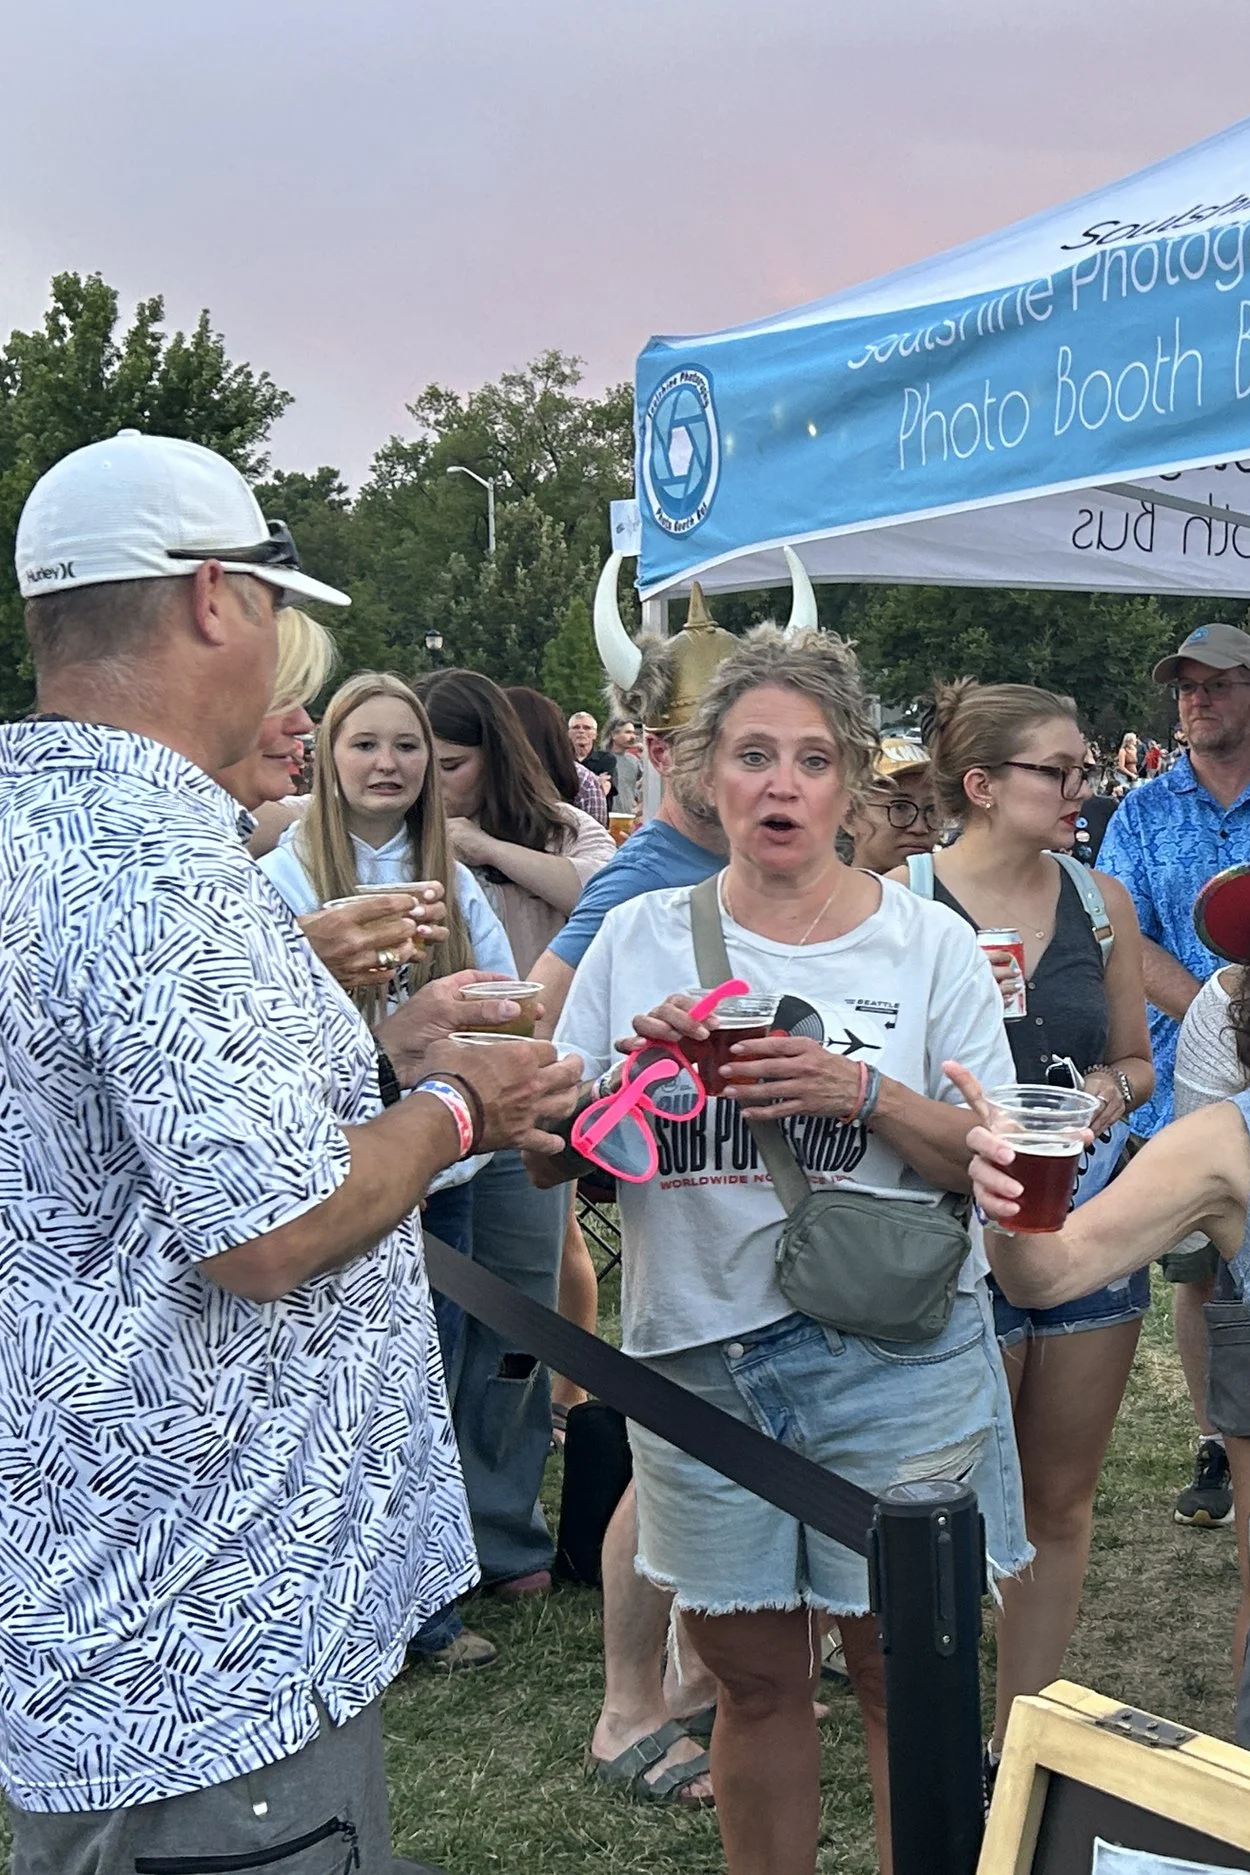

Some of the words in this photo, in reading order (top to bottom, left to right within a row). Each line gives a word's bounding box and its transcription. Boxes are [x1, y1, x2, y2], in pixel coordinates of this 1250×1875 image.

[900, 382, 1030, 470] Photo
[1054, 317, 1202, 436] Booth
[655, 1093, 707, 1175] SUB
[660, 1175, 747, 1190] WORLDWIDE
